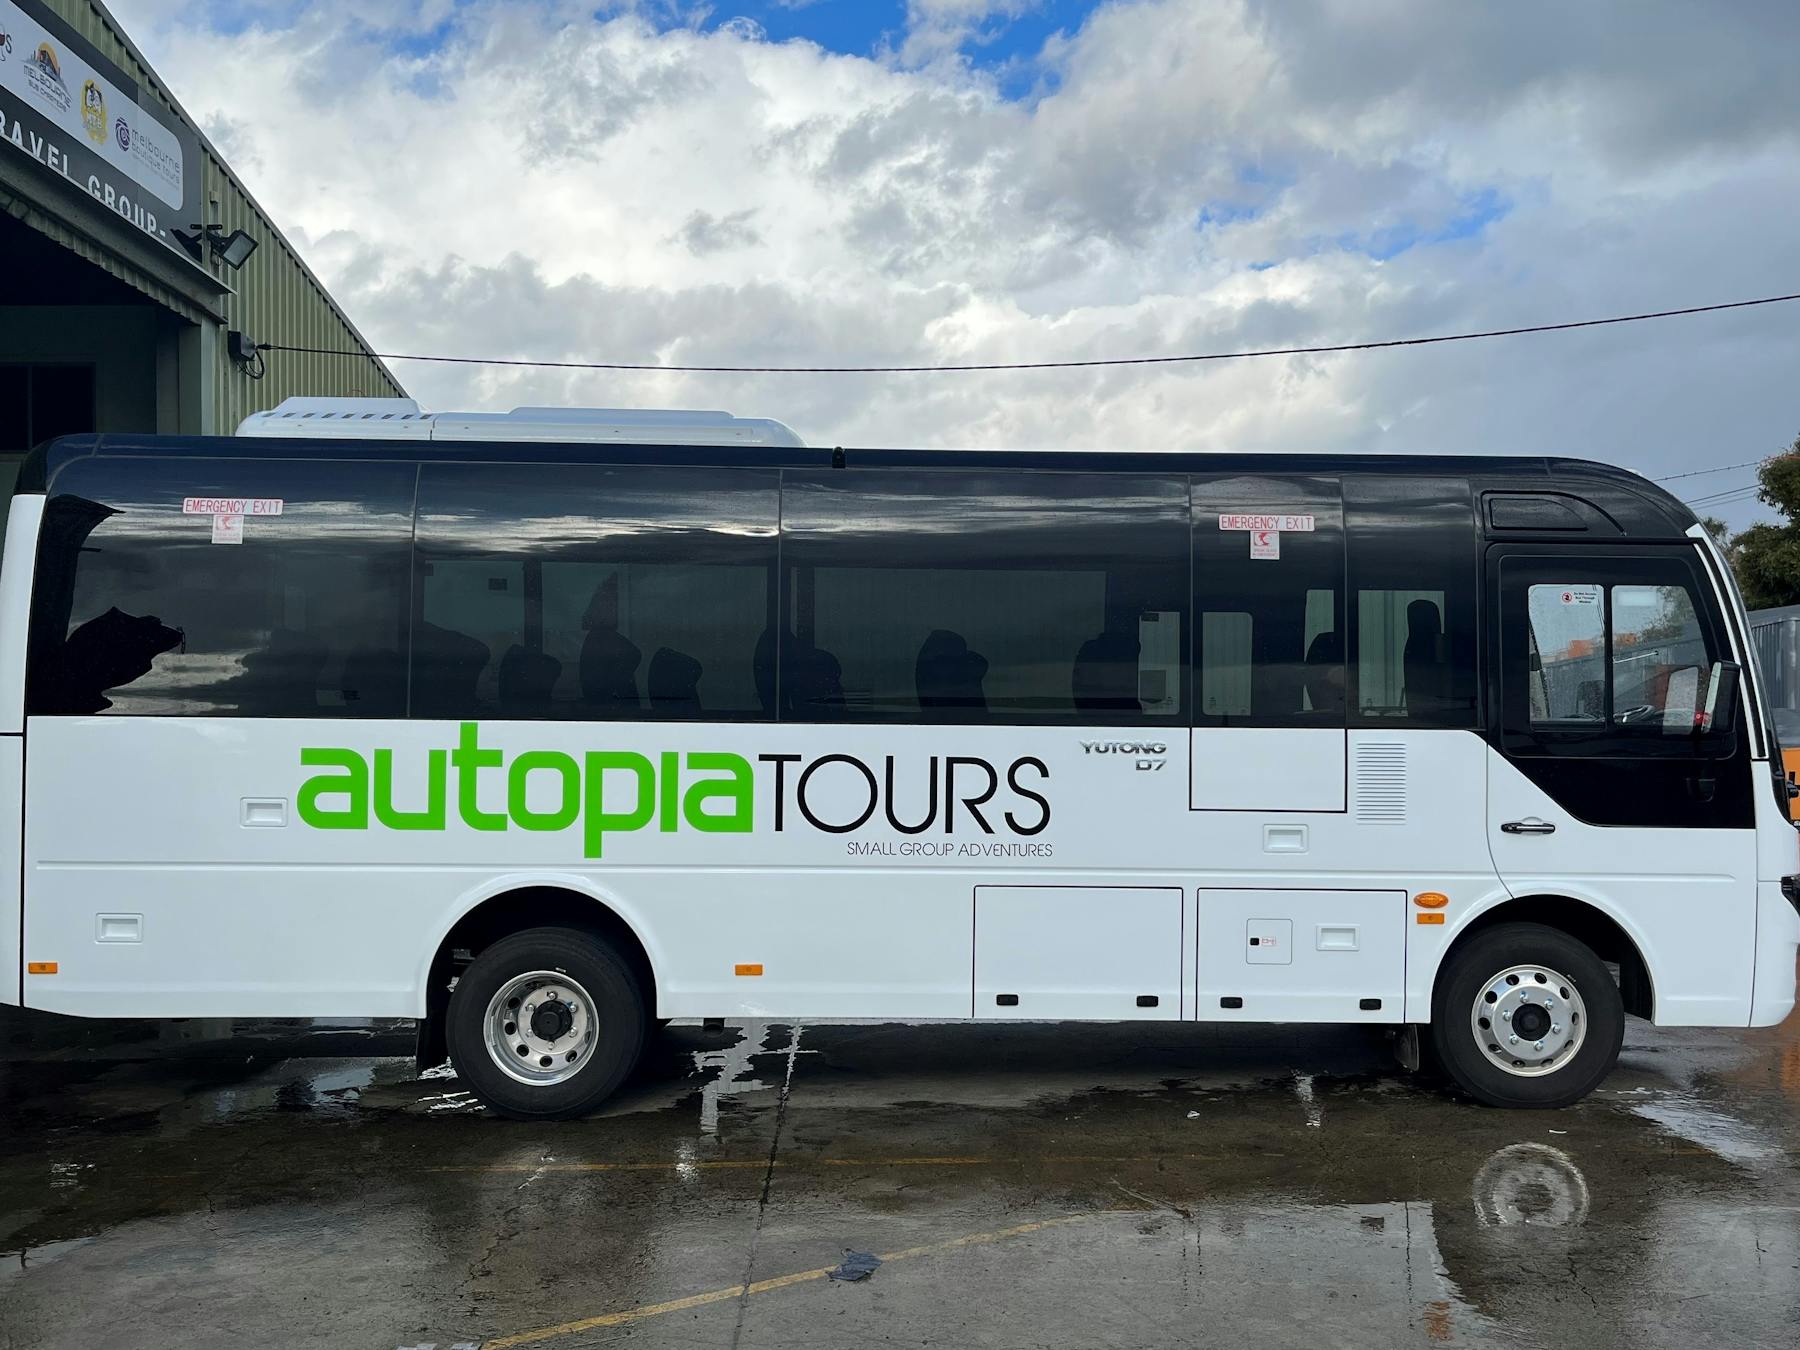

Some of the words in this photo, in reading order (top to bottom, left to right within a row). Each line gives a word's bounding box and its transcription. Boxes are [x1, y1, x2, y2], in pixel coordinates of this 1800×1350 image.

[131, 128, 181, 174] melbourne
[185, 500, 248, 513] EMERGENCY
[252, 501, 281, 514] EXIT
[1221, 516, 1280, 529] EMERGENCY
[1286, 517, 1312, 530] EXIT
[1079, 740, 1167, 754] YUTONG
[1135, 759, 1167, 771] D7
[297, 721, 754, 859] autopia
[758, 754, 1051, 836] TOURS
[847, 842, 897, 856] SMALL
[899, 842, 955, 856] GROUP
[957, 843, 1054, 857] ADVENTURES
